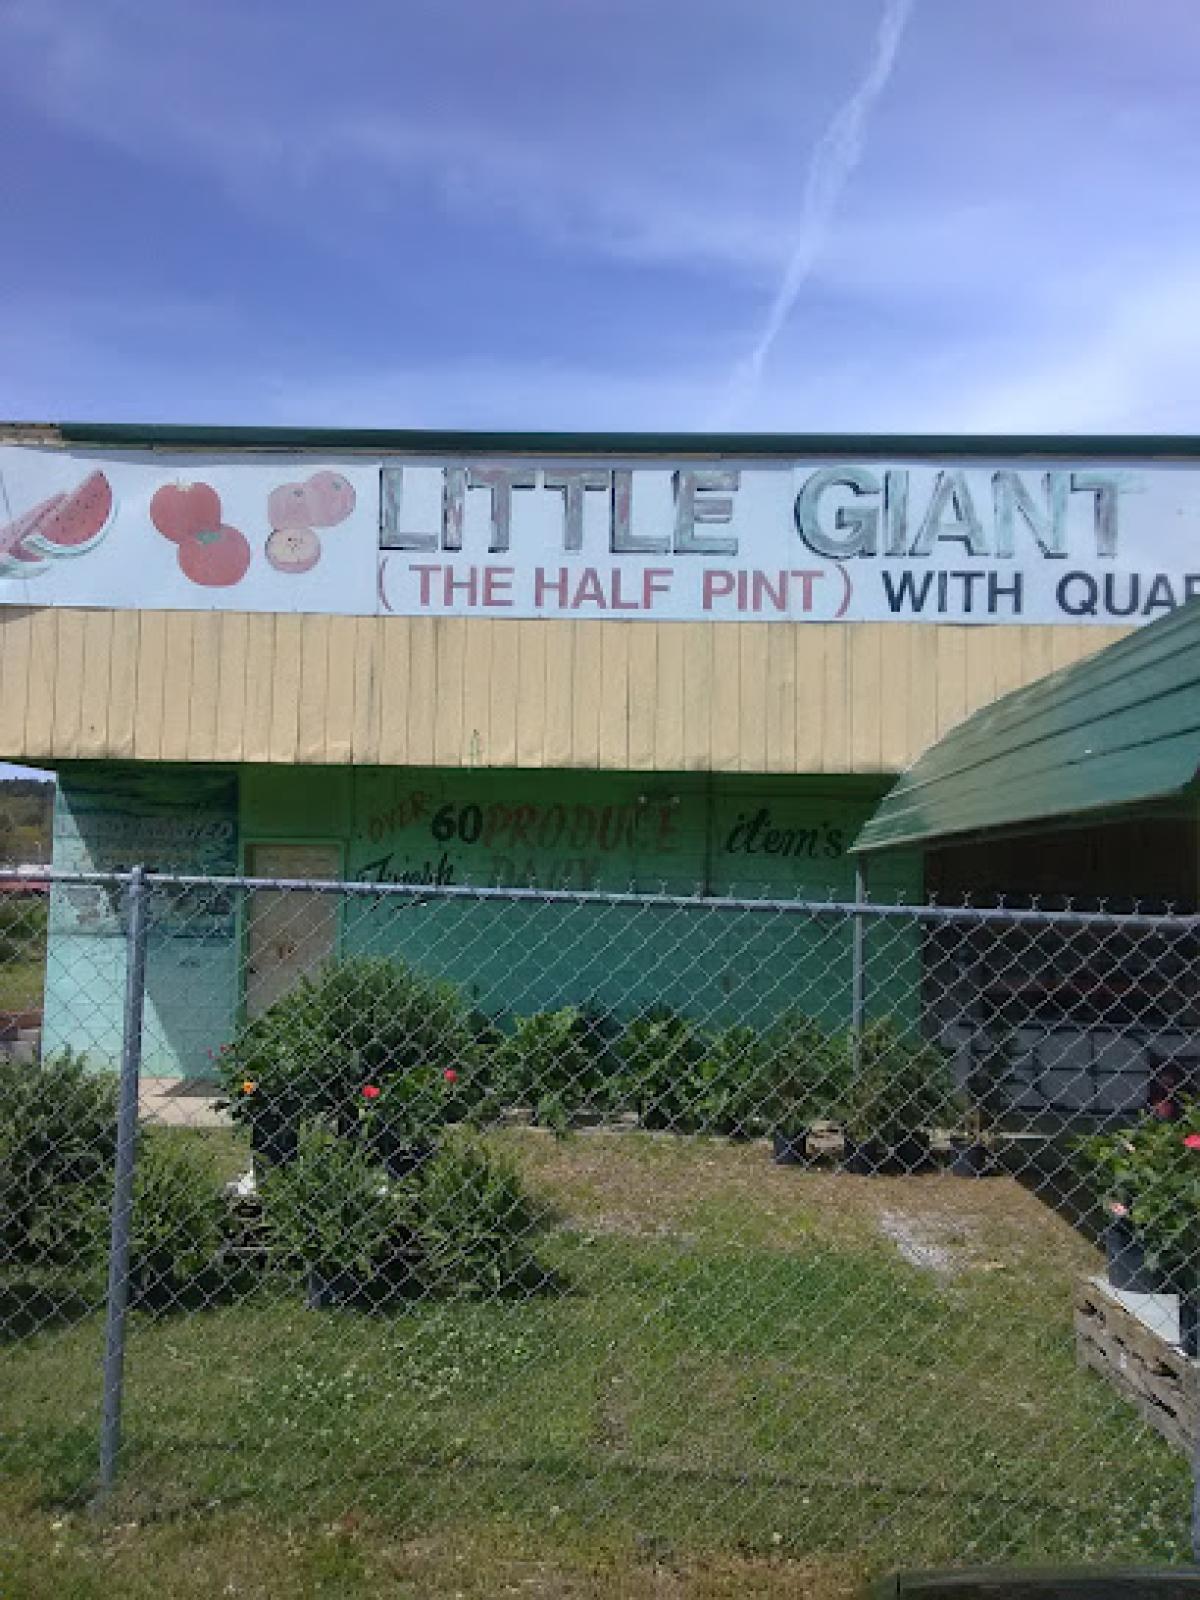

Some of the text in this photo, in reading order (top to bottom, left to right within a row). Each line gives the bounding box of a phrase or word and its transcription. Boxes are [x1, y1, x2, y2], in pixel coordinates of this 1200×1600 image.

[378, 464, 1142, 560] LITTLE GIANT
[534, 567, 674, 610] HALF
[881, 569, 1023, 614] WITH
[431, 805, 483, 844] 60
[484, 803, 681, 852] PRODUCE
[726, 808, 843, 859] item's
